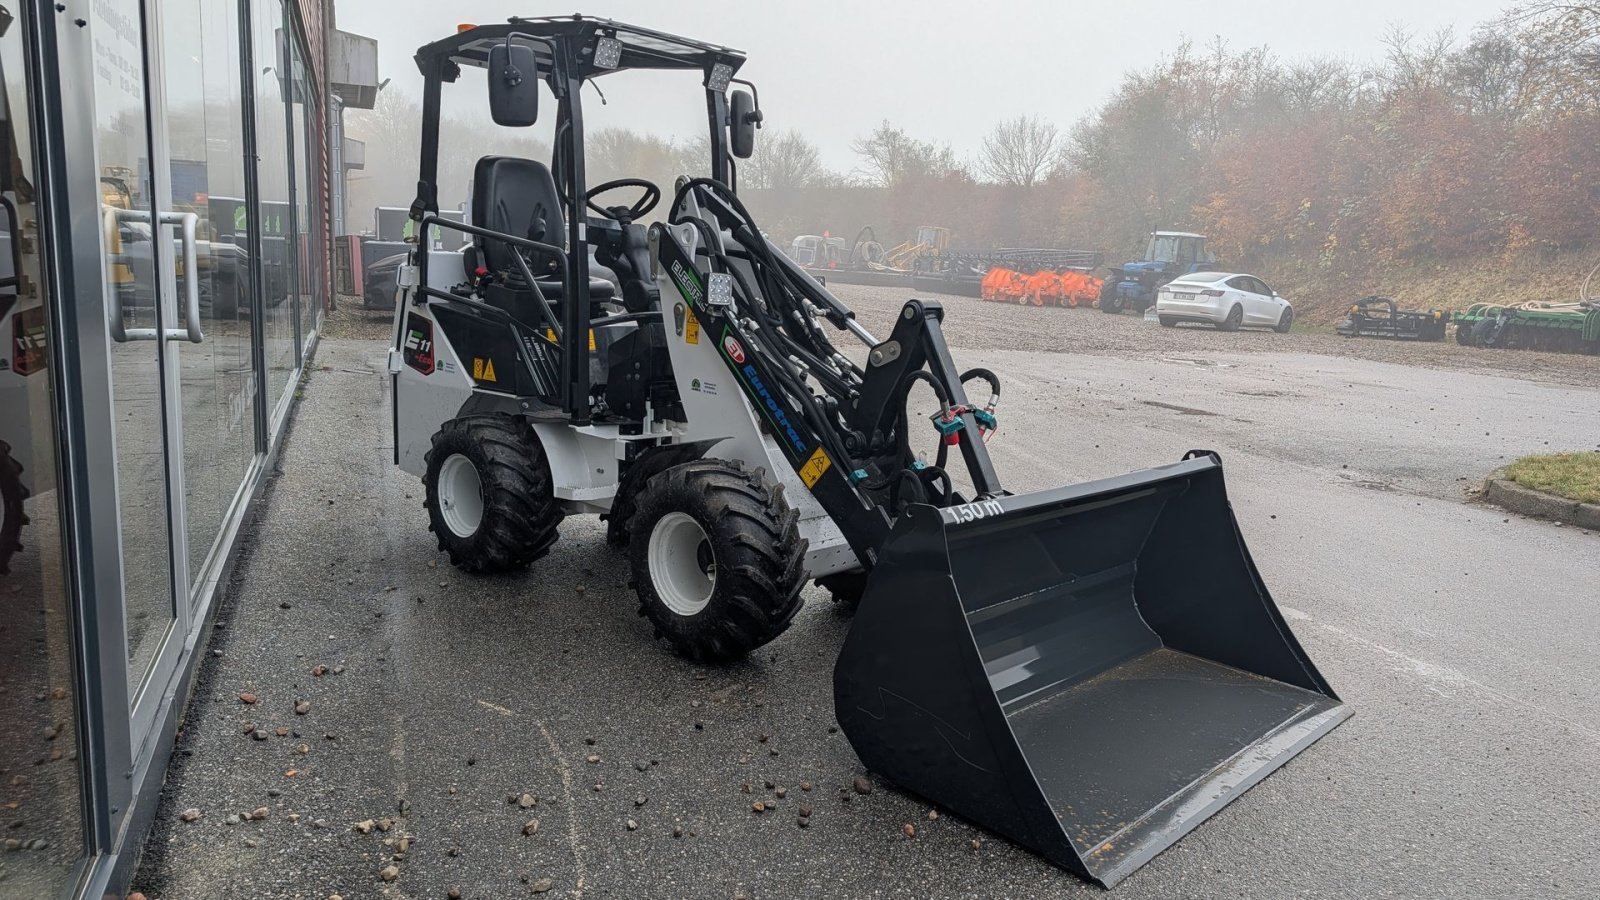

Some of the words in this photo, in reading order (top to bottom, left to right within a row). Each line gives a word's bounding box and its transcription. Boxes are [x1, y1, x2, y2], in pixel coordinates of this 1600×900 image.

[743, 364, 807, 453] Eurotrac
[946, 503, 985, 525] 1.50
[985, 500, 1005, 517] m
